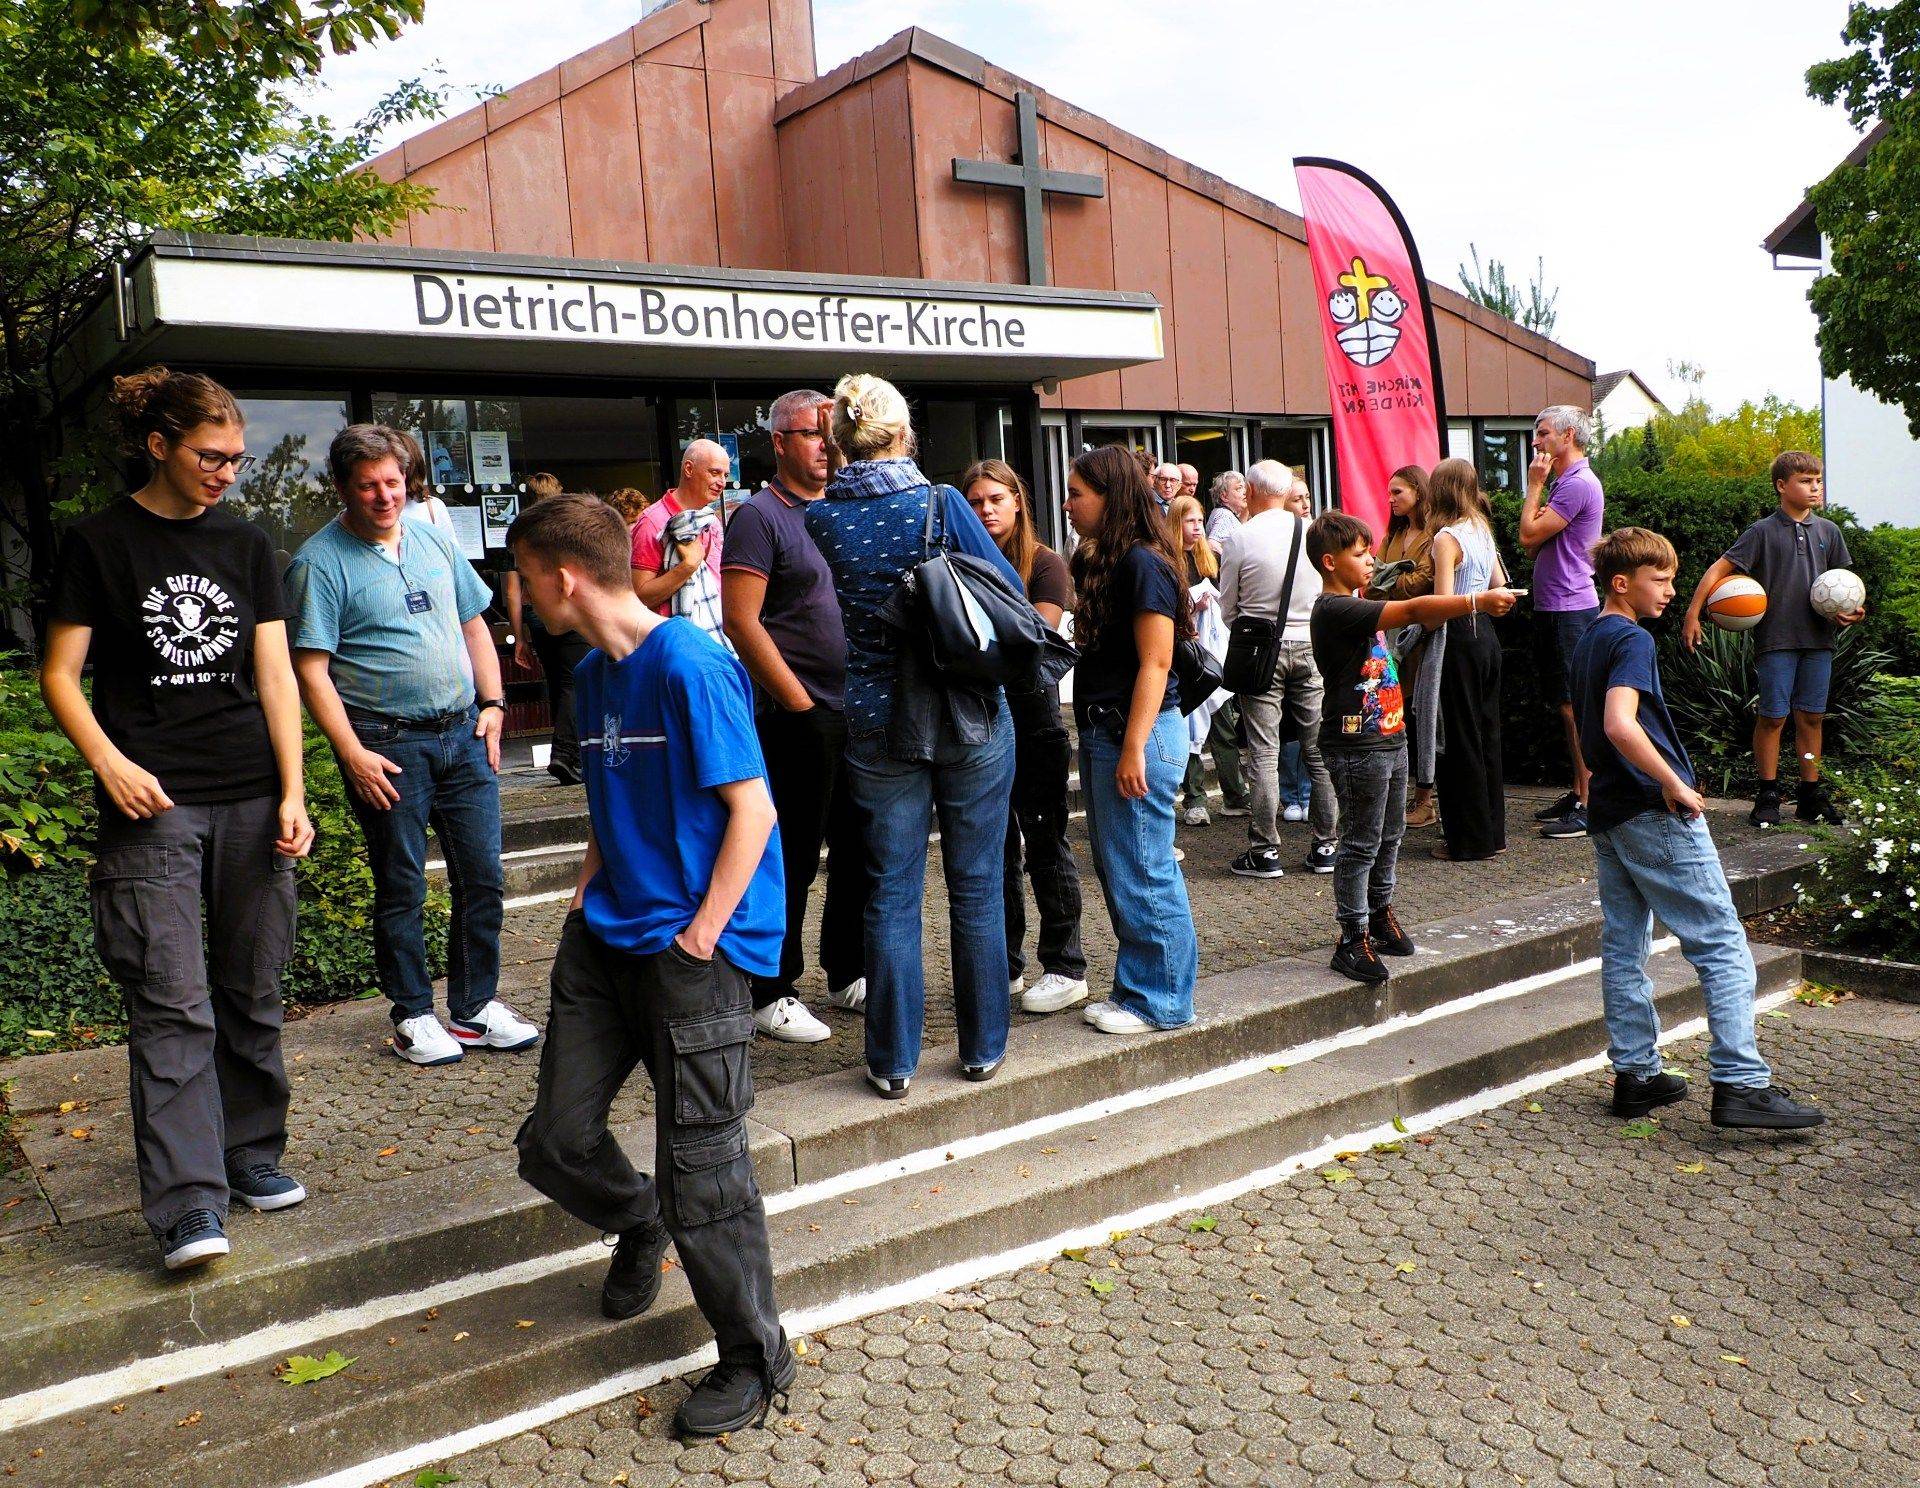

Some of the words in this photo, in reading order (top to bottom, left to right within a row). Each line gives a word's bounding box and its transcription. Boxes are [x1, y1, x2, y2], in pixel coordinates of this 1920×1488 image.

[413, 274, 1026, 348] Dietrich-Bonhoeffer-Kirche
[142, 586, 169, 612] DIE
[166, 574, 235, 613] GIFTBUDE
